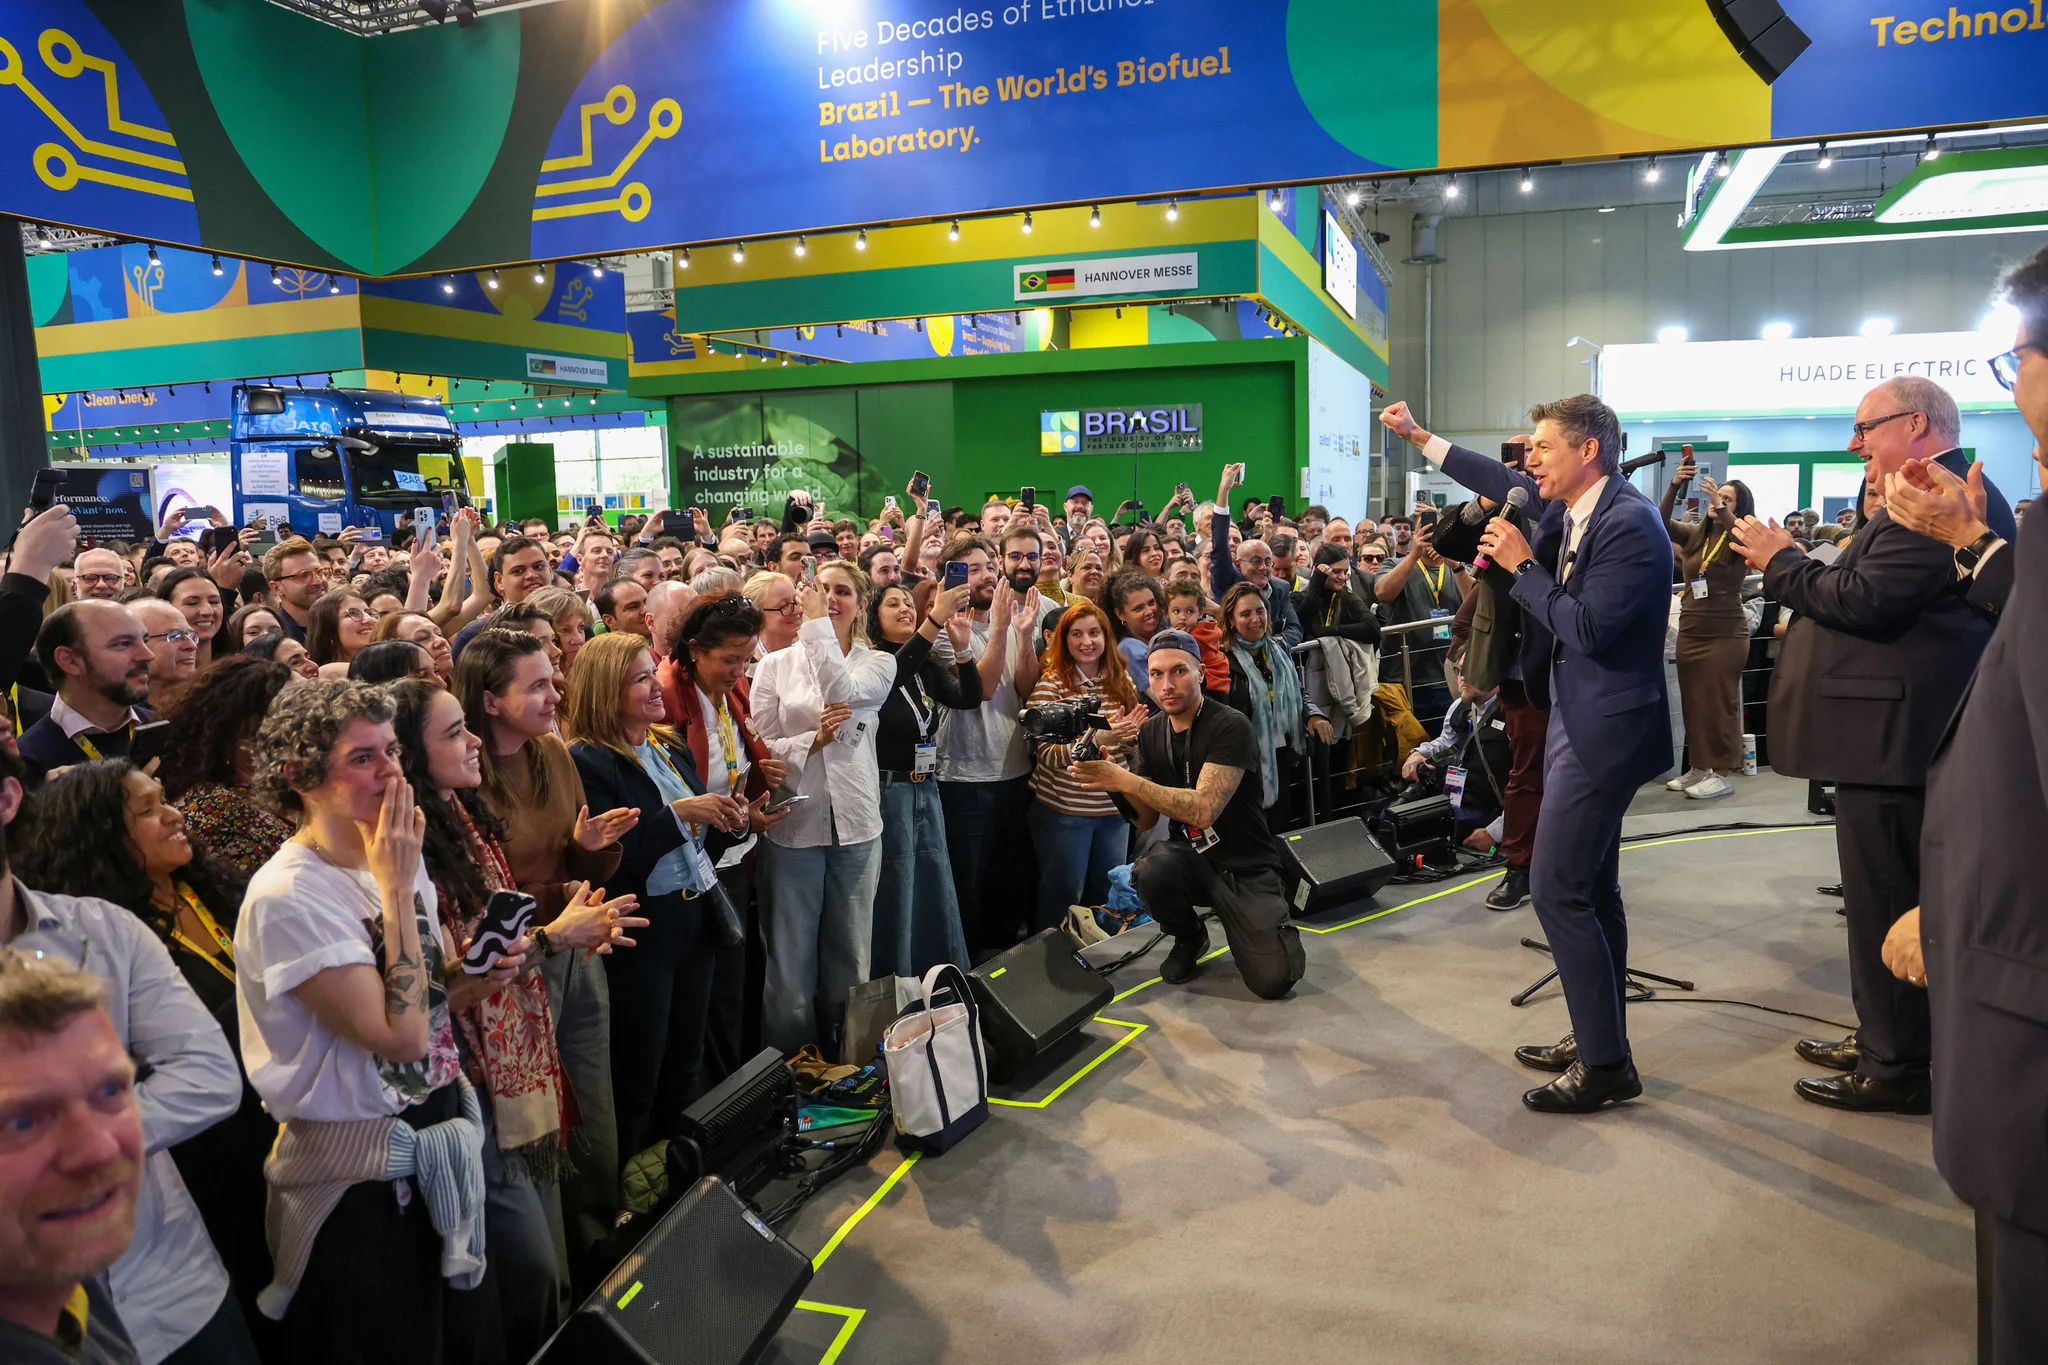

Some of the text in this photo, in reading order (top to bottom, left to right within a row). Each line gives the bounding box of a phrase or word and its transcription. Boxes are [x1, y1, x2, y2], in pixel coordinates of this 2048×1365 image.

[817, 0, 1155, 55] Five Decades of Ethan
[1869, 0, 2048, 47] Technol
[818, 47, 963, 90] Leadership
[818, 90, 901, 127] Brazil
[938, 81, 990, 109] The
[996, 64, 1109, 102] World's
[1116, 46, 1233, 87] Biofuel
[819, 125, 981, 164] Laboratory.
[1085, 265, 1192, 283] HANNOVER MESSE
[559, 365, 589, 375] HANNOVER
[1780, 364, 1858, 382] HUADE
[83, 393, 117, 408] Clean
[1085, 410, 1199, 436] BRASIL
[1106, 435, 1151, 443] INDUSRY
[693, 440, 805, 459] A sustainable
[694, 463, 803, 483] industry for a
[55, 494, 110, 503] rformance.
[695, 485, 826, 506] changing wld.
[69, 506, 103, 515] eVant
